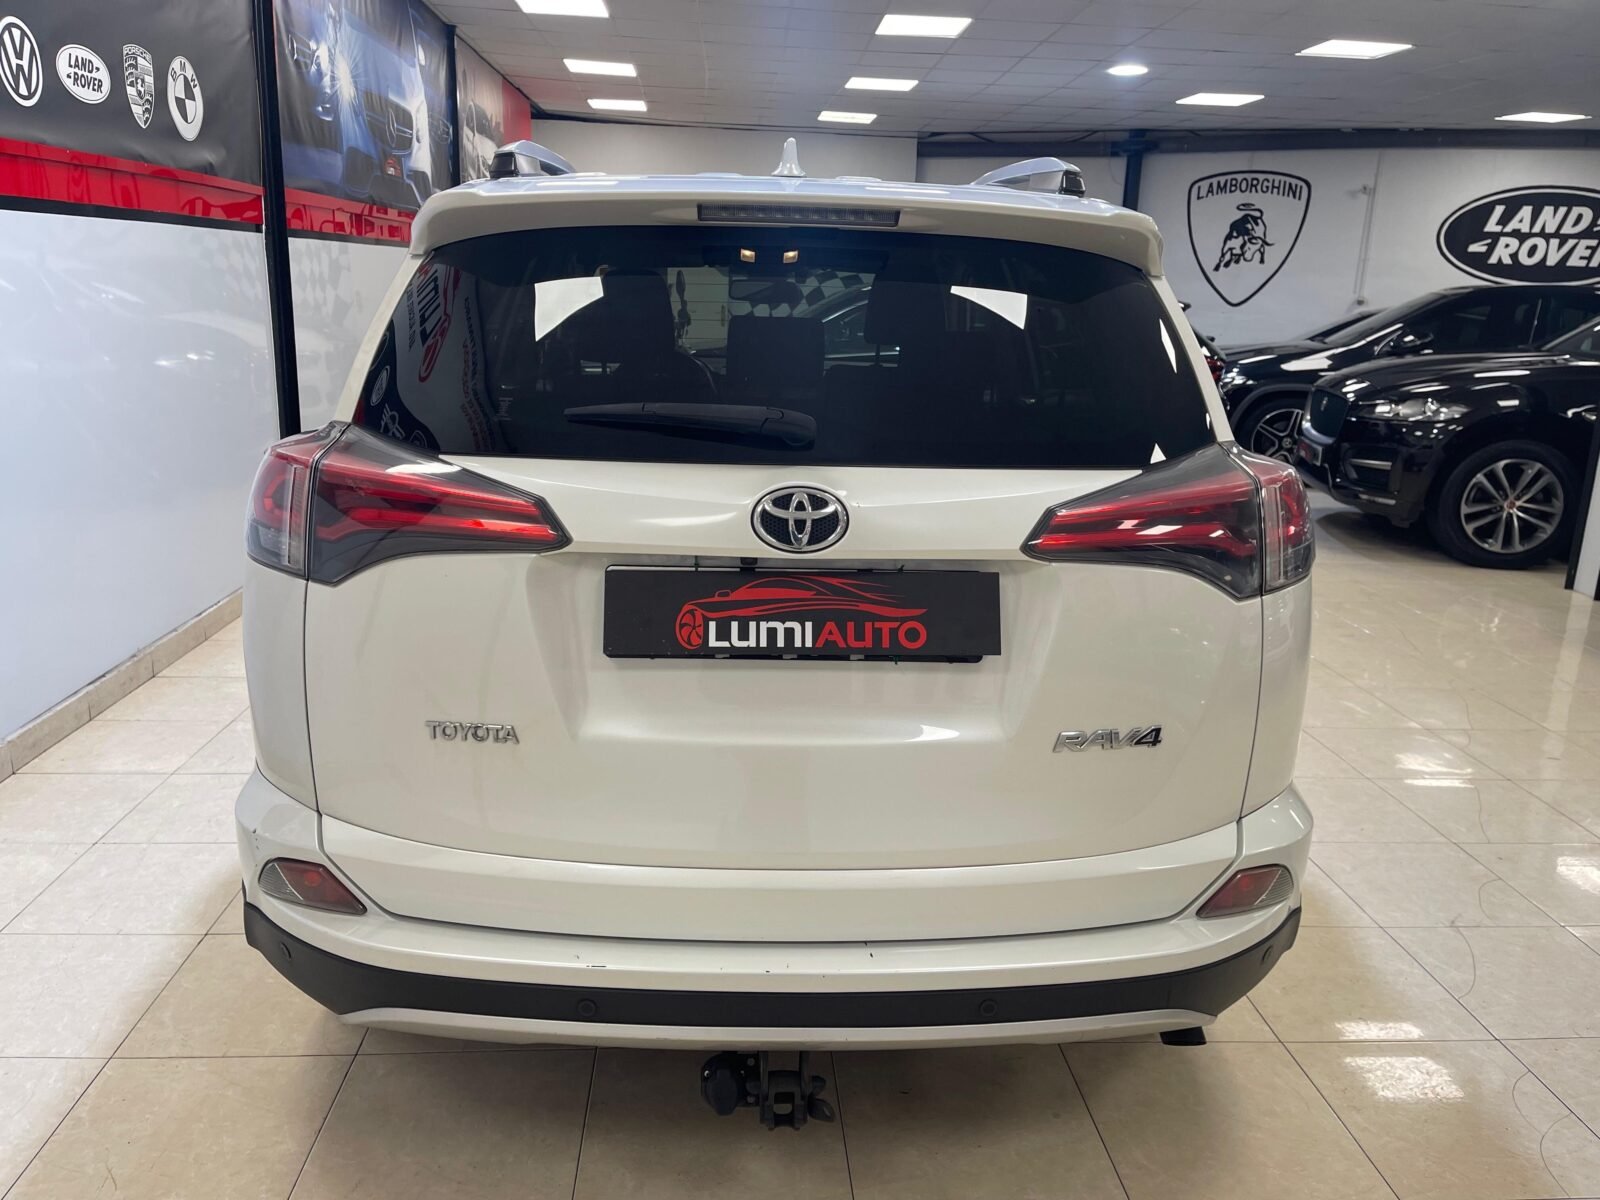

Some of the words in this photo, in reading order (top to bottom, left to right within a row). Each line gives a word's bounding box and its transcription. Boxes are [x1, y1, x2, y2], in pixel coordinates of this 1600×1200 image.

[67, 52, 95, 74] LAND
[170, 59, 198, 89] BMW
[72, 71, 103, 94] ROVER
[1196, 177, 1303, 201] LAMBORGHINI
[1483, 204, 1594, 235] LAND
[707, 619, 928, 650] LUMIAUTO
[425, 720, 520, 744] TOYOTA
[1052, 725, 1162, 753] RAV4
